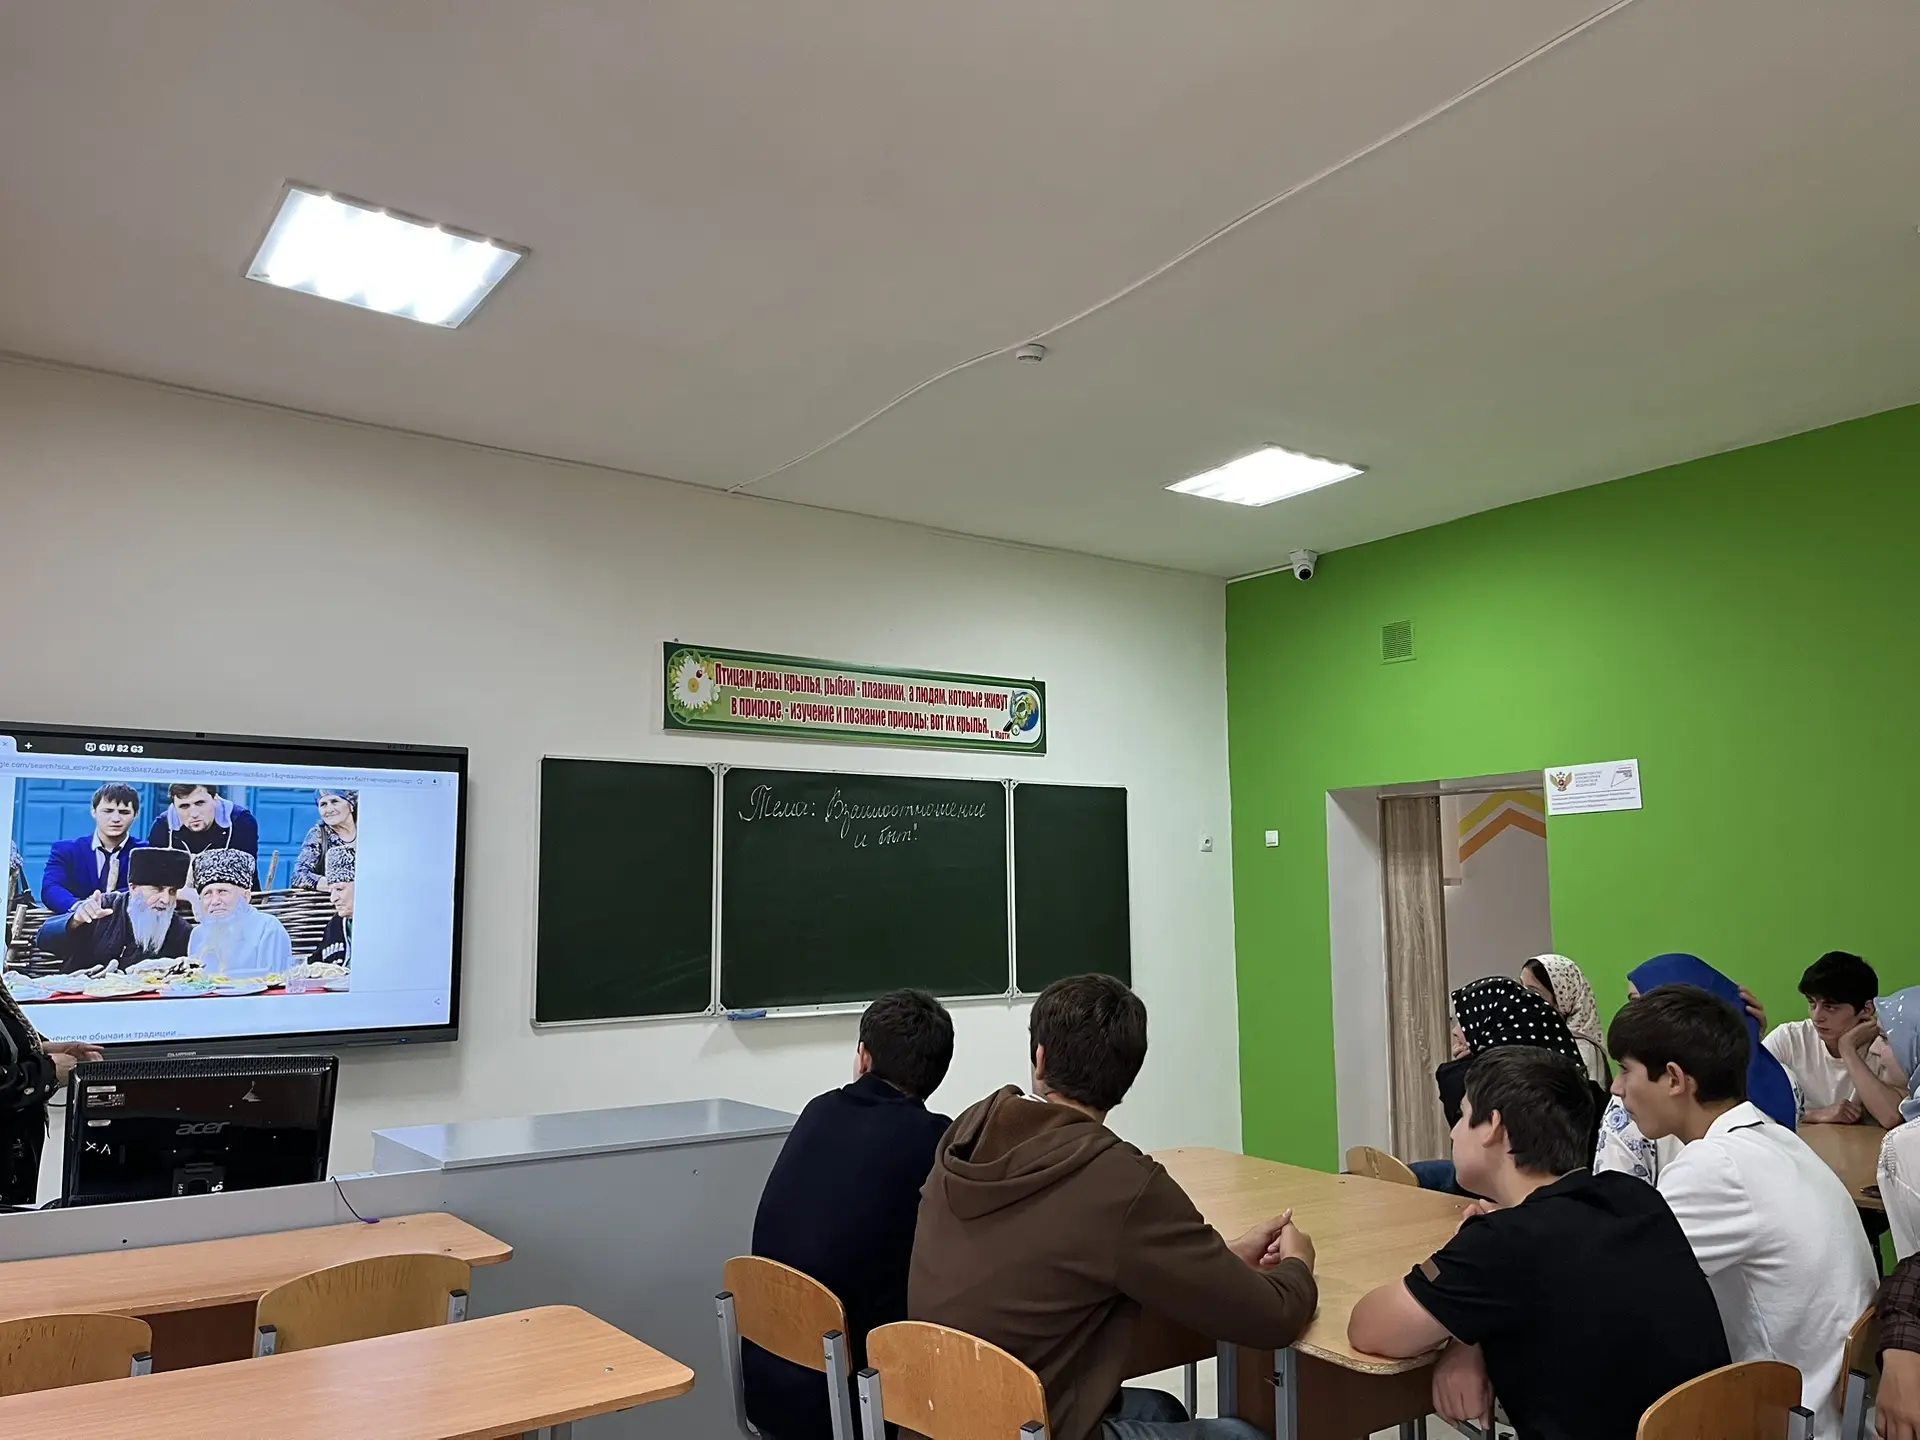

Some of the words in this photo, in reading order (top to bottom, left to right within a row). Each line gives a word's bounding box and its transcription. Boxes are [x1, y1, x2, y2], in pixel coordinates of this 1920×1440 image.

[715, 662, 753, 689] Птицам
[755, 670, 782, 691] даны
[784, 673, 823, 696] крылья,
[824, 675, 856, 697] рыбам
[861, 681, 906, 703] плавники,
[908, 685, 915, 702] а
[915, 686, 948, 706] людям,
[948, 689, 983, 709] которые
[984, 692, 1008, 711] живут
[730, 697, 738, 715] в
[739, 697, 784, 721] природе,
[790, 702, 835, 722] изучение
[836, 706, 842, 723] и
[843, 706, 886, 727] познание
[887, 710, 929, 731] природы;
[930, 714, 945, 730] вот
[945, 715, 955, 731] их
[956, 716, 989, 734] крылья.
[99, 744, 115, 752] GW
[117, 744, 129, 753] 82
[131, 745, 144, 753] G3
[738, 784, 816, 822] Тема:
[853, 833, 869, 849] и
[89, 1032, 126, 1042] обычаи
[134, 1029, 177, 1040] традиции
[175, 1121, 230, 1135] acer
